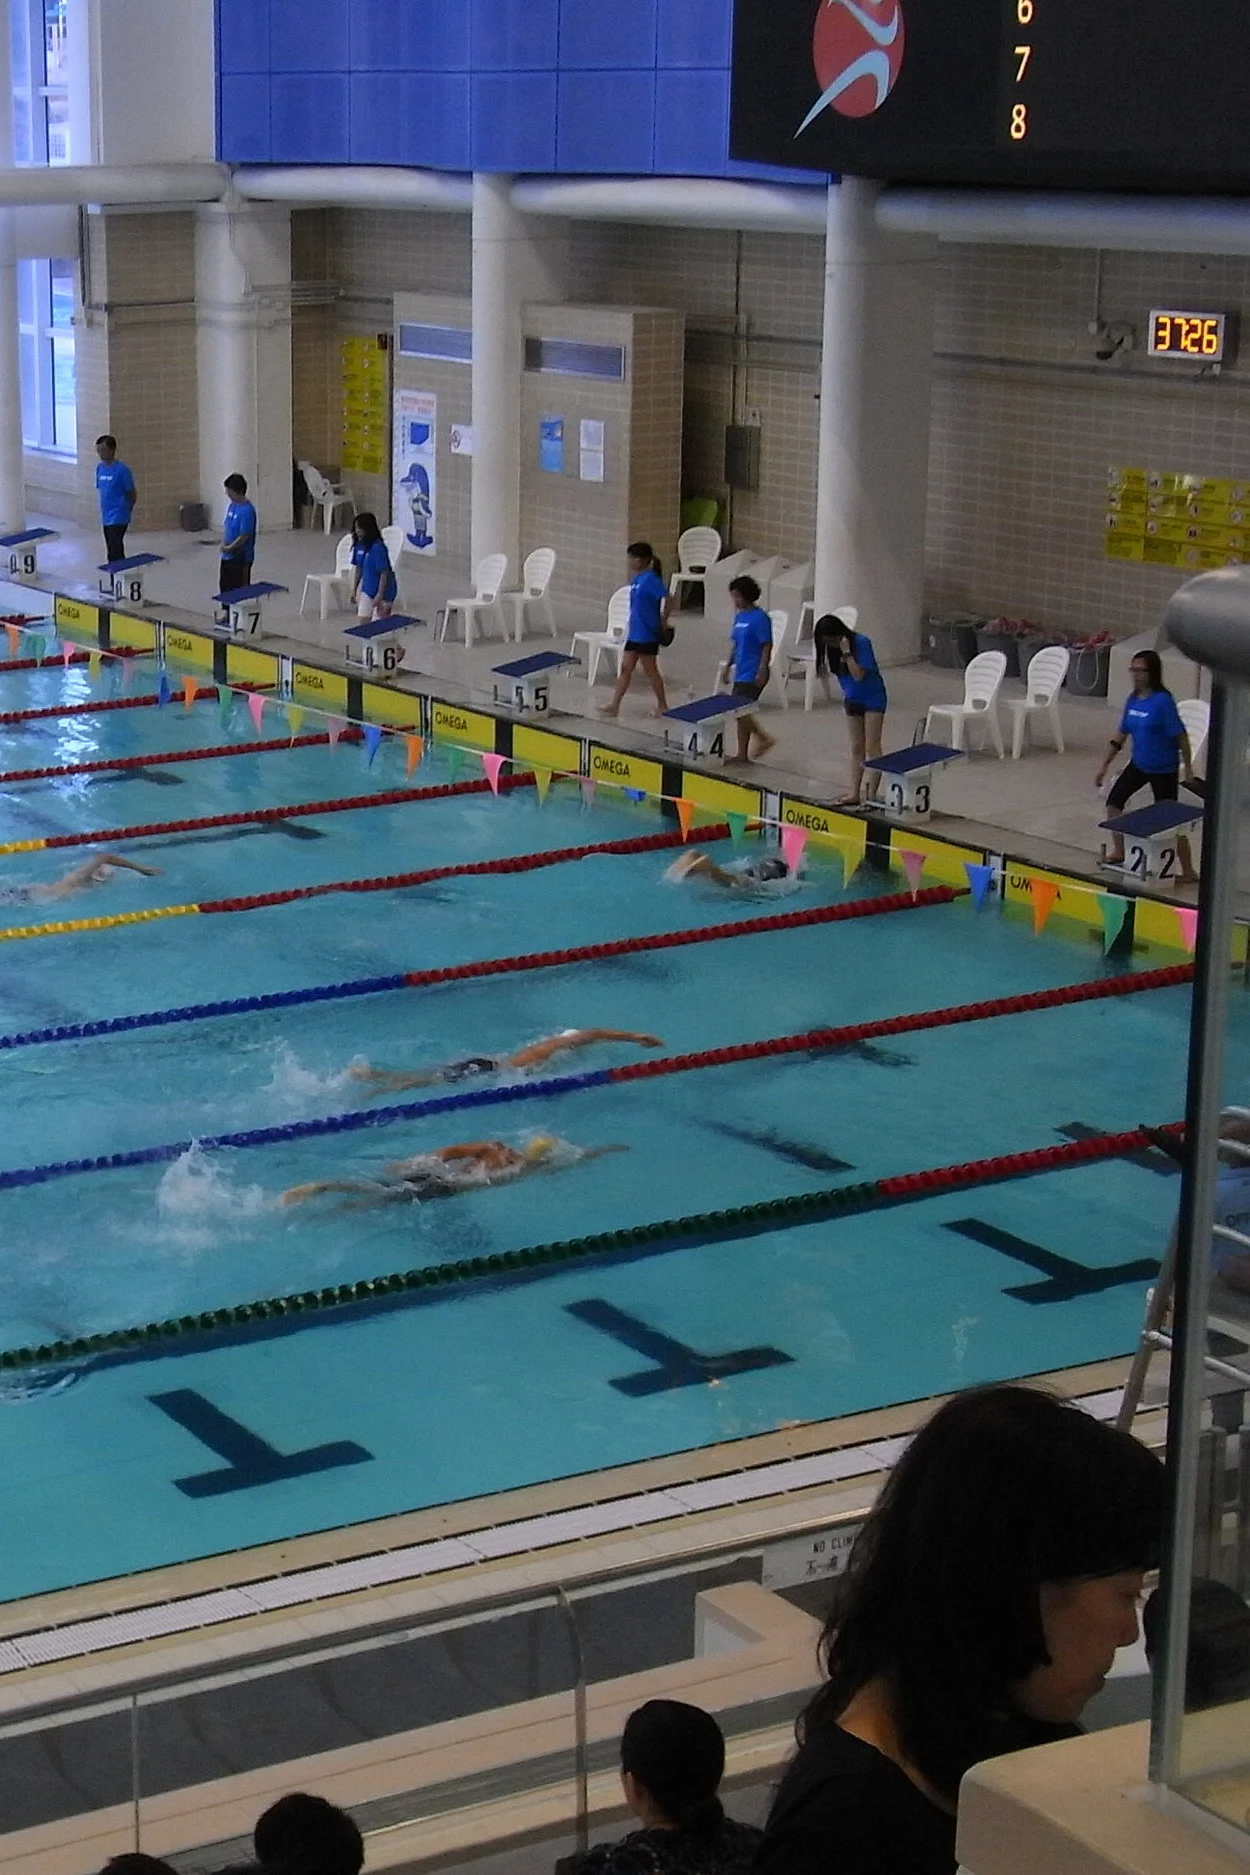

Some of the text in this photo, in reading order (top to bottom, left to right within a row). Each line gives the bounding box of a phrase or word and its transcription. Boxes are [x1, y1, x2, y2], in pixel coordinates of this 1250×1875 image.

[1018, 0, 1033, 24] 6
[1014, 45, 1031, 82] 7
[1011, 103, 1026, 139] 8
[24, 554, 35, 574] 9
[130, 581, 141, 602] 8
[248, 612, 260, 634] 7
[383, 647, 396, 670] 6
[295, 673, 324, 689] OMEGA
[534, 686, 548, 712] 5
[435, 712, 467, 732] OMEGA
[709, 732, 723, 758] 4
[593, 755, 630, 777] OMEGA
[915, 785, 930, 813] 3
[786, 809, 829, 833] OMEGA
[1130, 845, 1145, 873] 2
[1159, 848, 1176, 879] 2
[813, 1541, 825, 1554] NO
